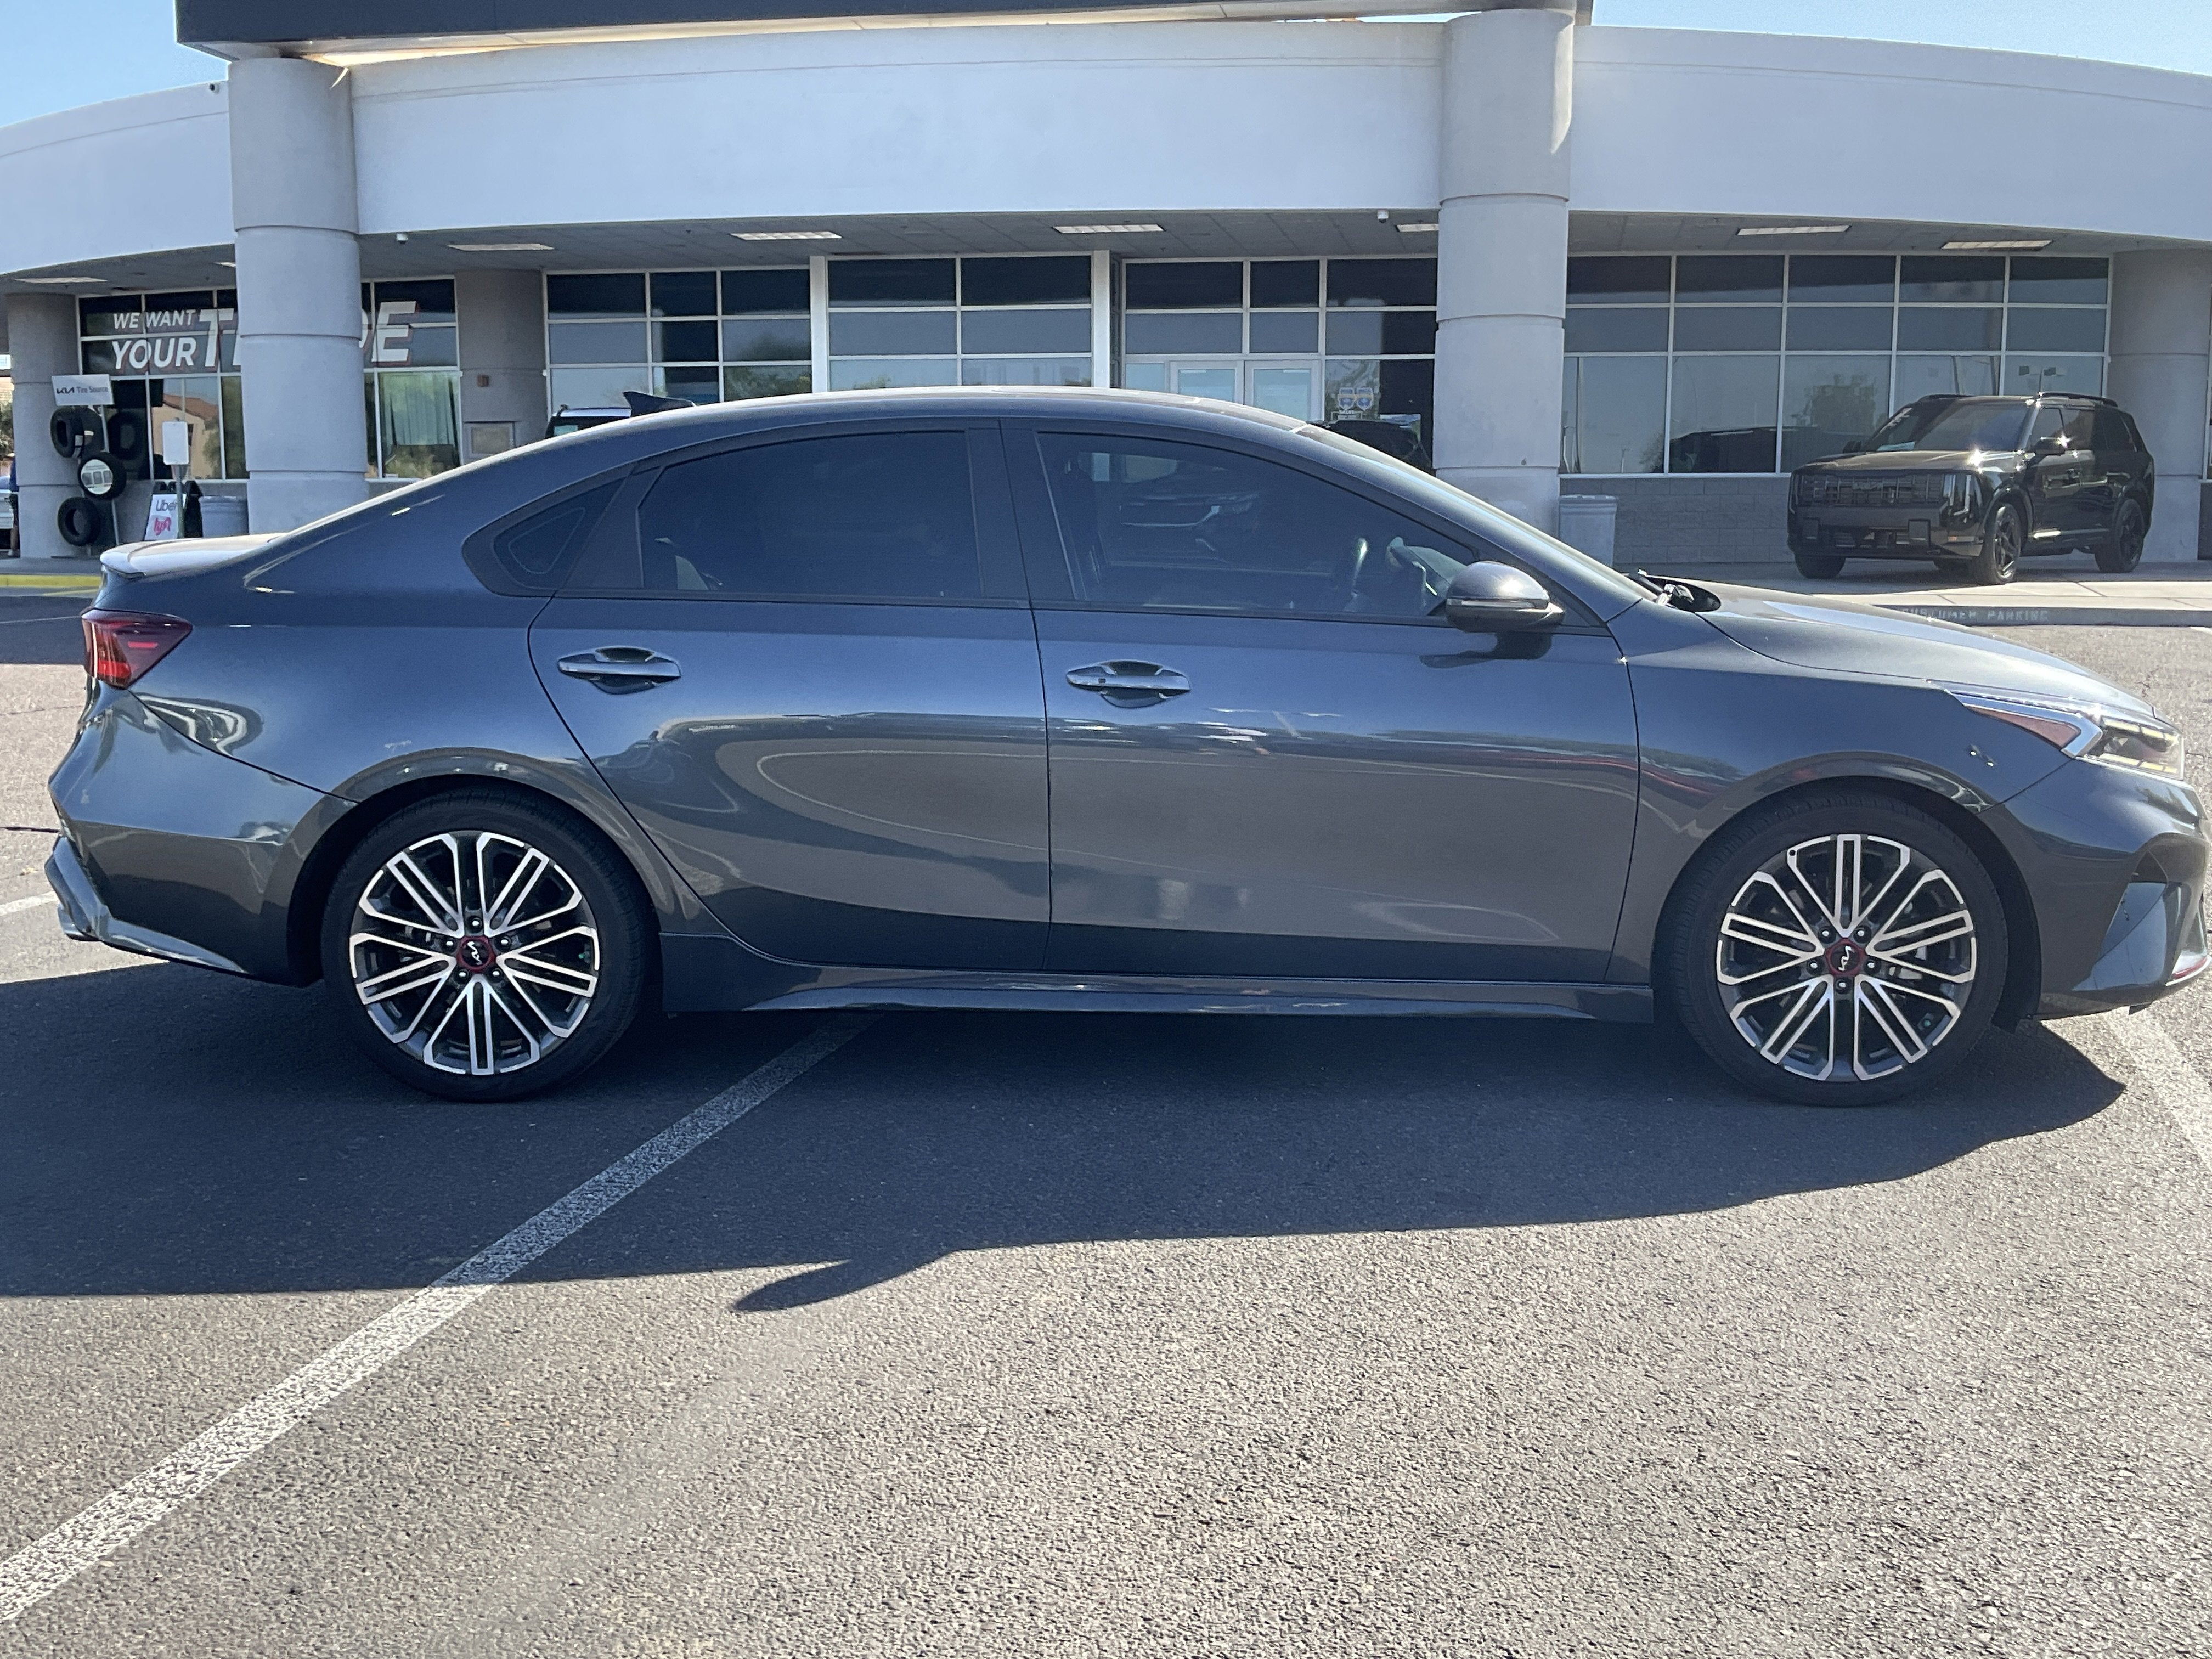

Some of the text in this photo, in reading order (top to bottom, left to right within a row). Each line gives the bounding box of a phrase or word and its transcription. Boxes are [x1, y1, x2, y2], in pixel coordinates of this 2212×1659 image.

[113, 309, 196, 329] WE WANT
[111, 337, 197, 370] YOUR
[156, 499, 178, 511] Uber
[1987, 610, 2049, 622] PARKING
